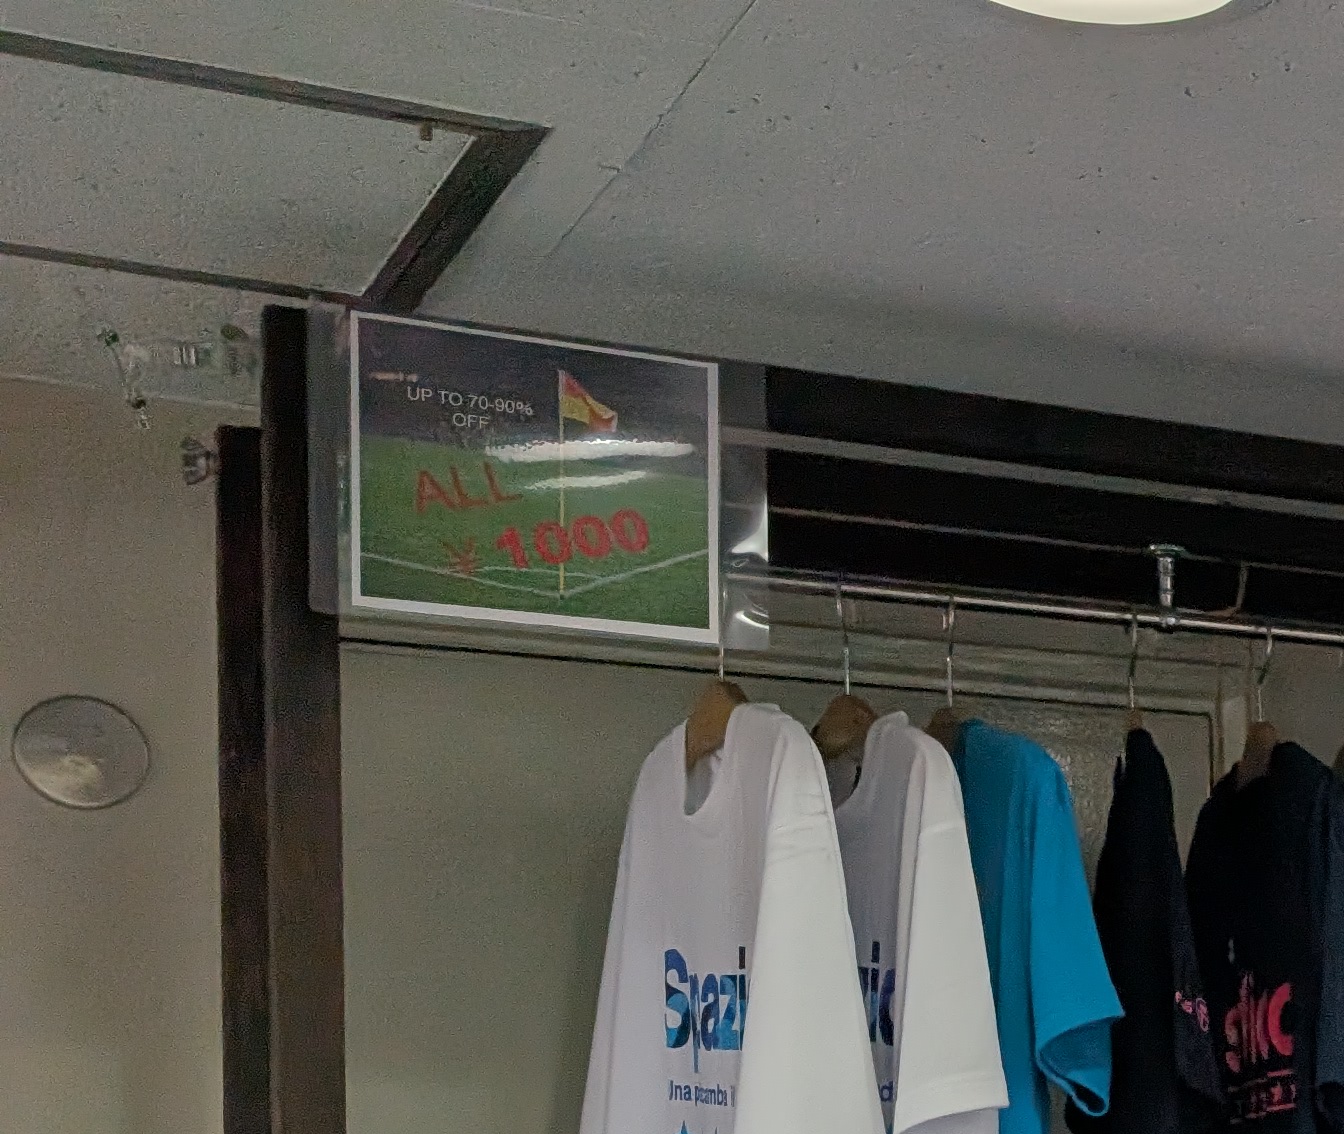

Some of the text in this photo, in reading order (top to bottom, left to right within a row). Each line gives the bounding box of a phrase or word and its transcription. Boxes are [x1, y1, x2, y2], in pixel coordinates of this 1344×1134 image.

[406, 385, 534, 416] UP TO 70-90%
[452, 412, 491, 429] OFF
[416, 461, 524, 514] ALL
[664, 946, 750, 1073] Spazi
